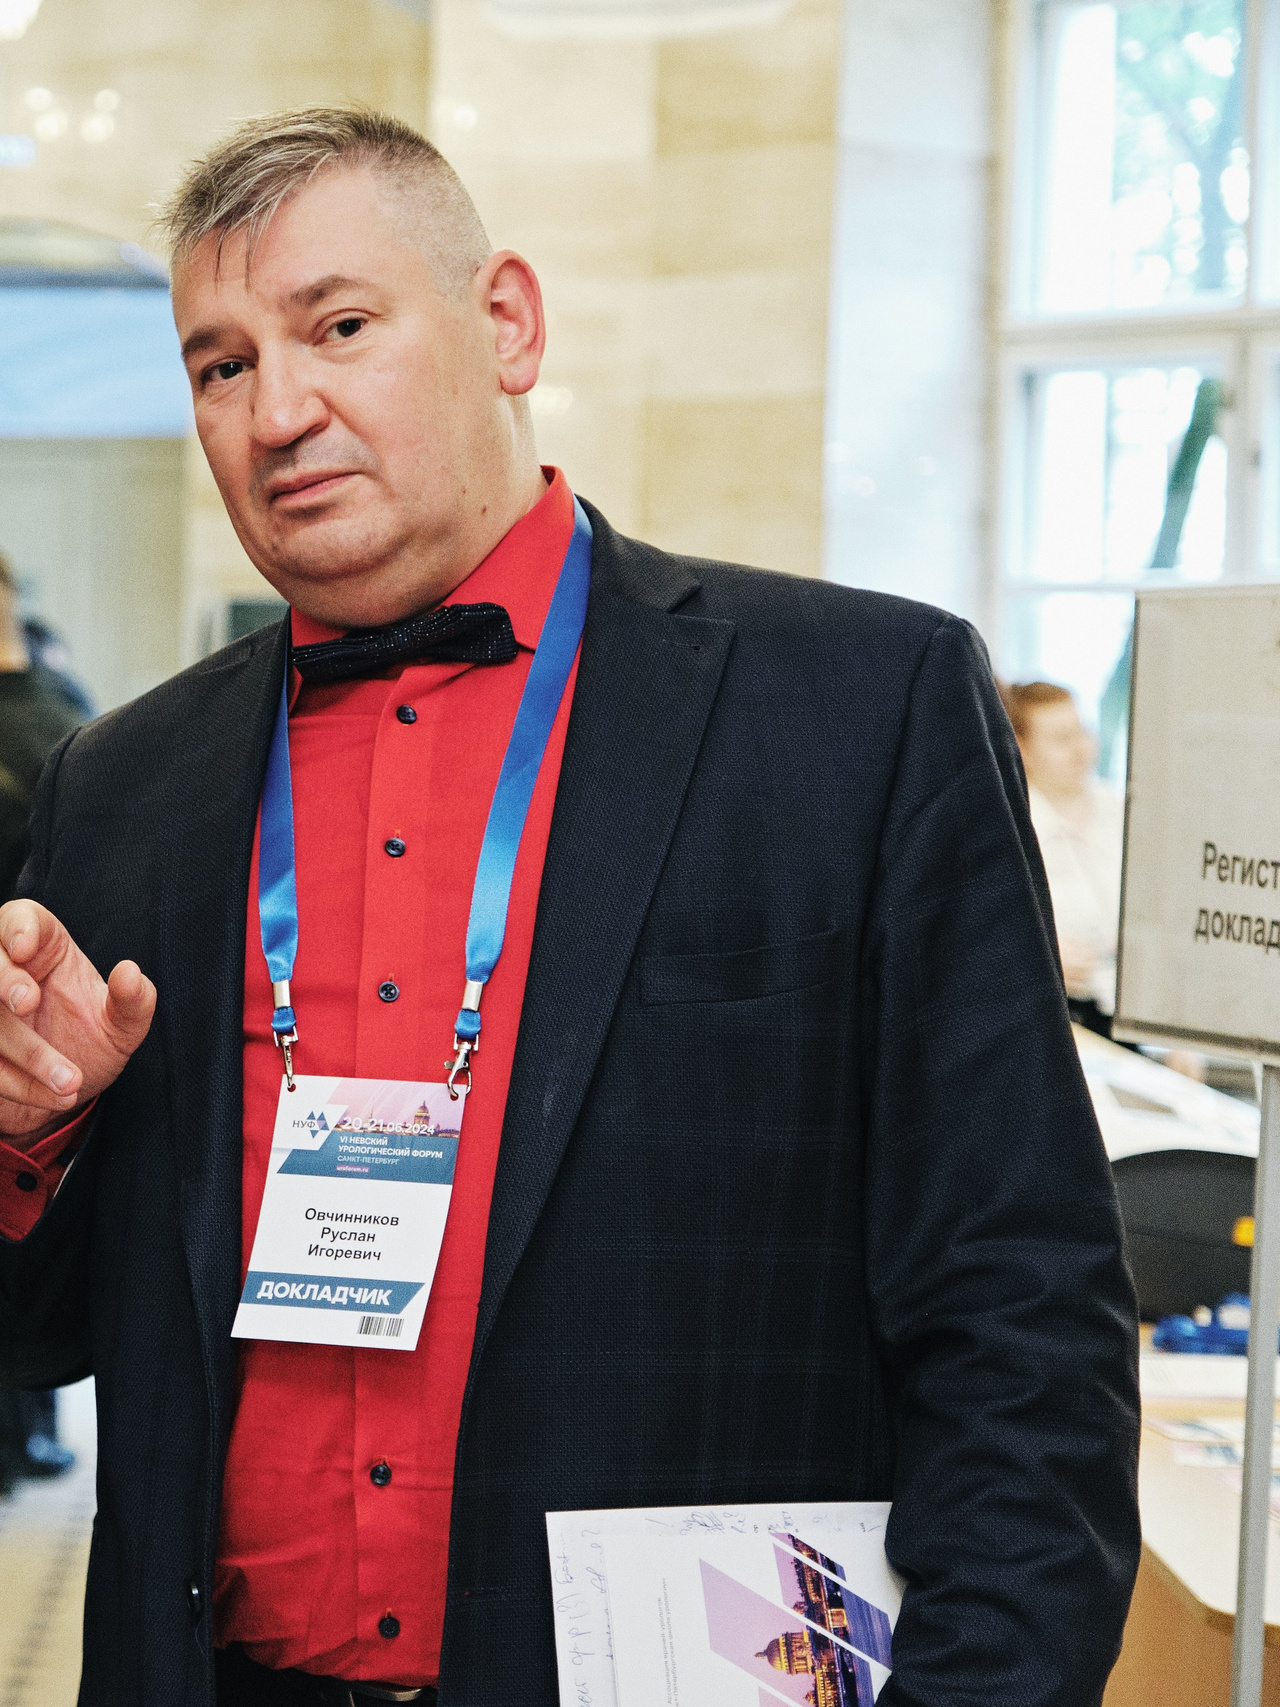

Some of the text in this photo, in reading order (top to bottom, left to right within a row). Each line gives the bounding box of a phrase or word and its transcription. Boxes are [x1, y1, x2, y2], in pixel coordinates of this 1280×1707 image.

[1202, 841, 1280, 889] Регист
[1194, 907, 1280, 956] доклад
[292, 1119, 316, 1129] НУФ
[340, 1135, 388, 1146] VI НЕВСКИЙ
[337, 1155, 400, 1165] САНКТ-ПЕТЕРБУРГ
[338, 1144, 443, 1159] УРОЛОГИЧЕСКИЙ ФОРУМ
[304, 1207, 400, 1226] Овчинников
[320, 1226, 376, 1243] Руслан
[308, 1243, 382, 1261] Игоревич
[256, 1280, 393, 1306] ДОКЛАДЧИК
